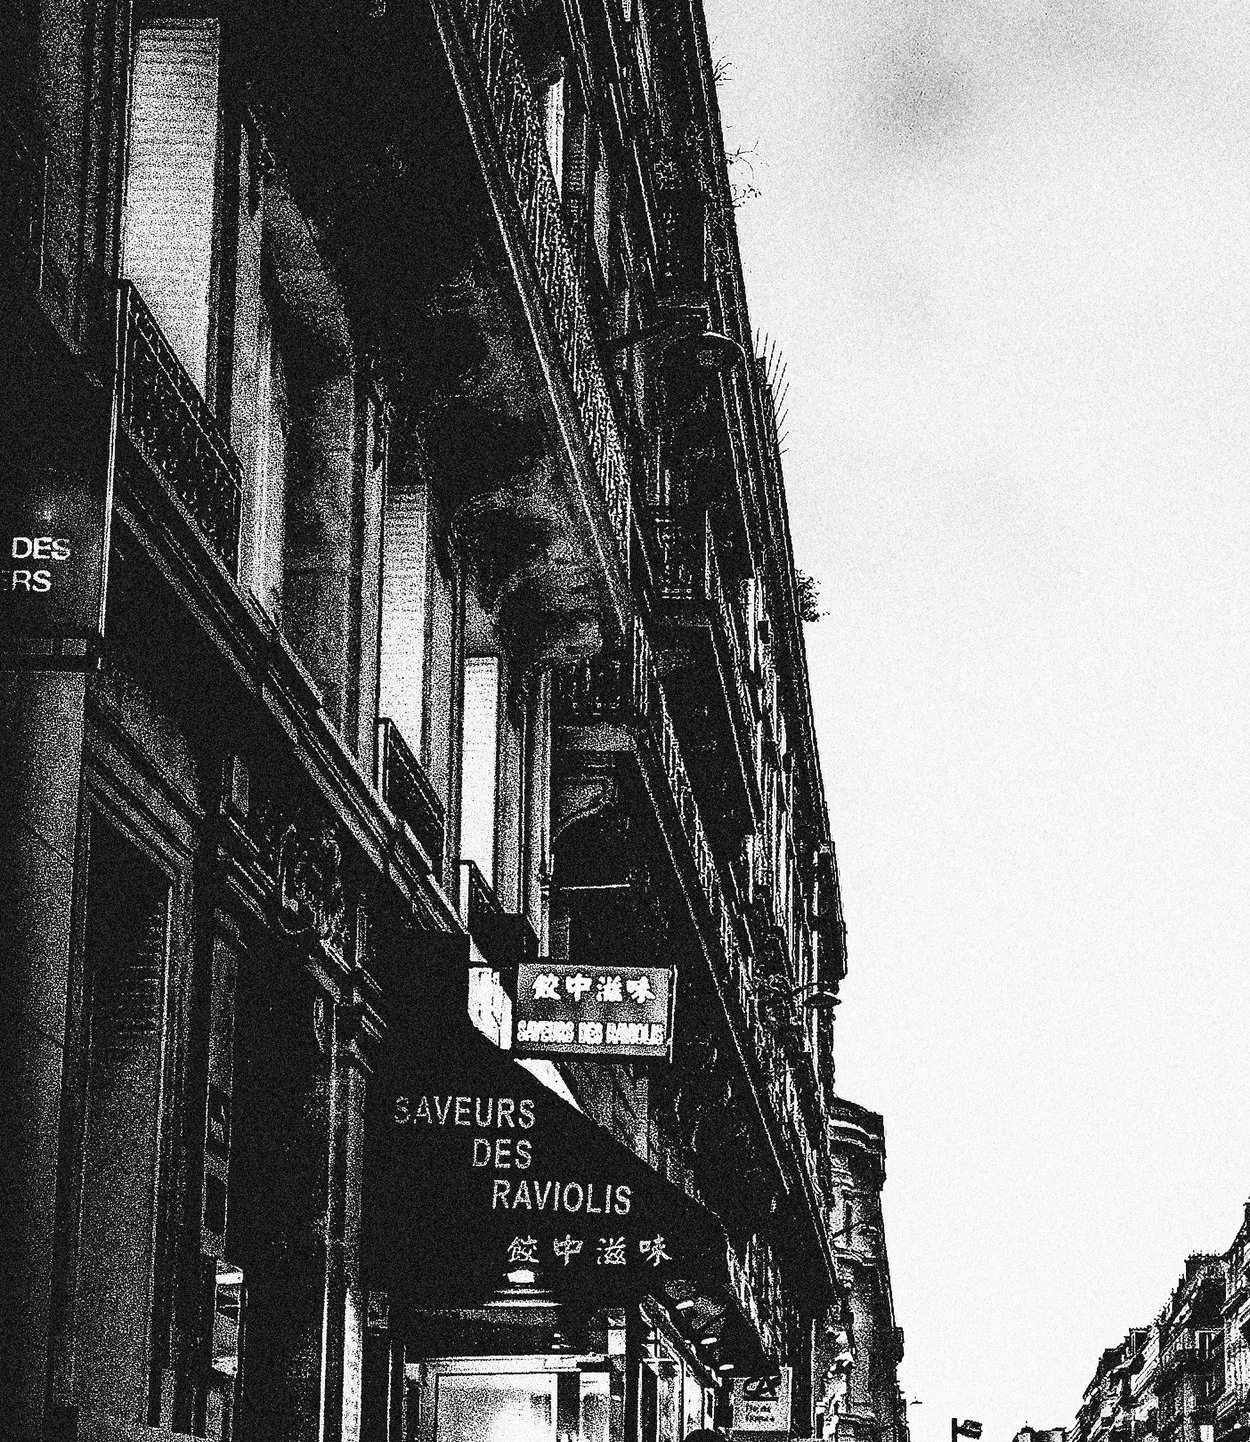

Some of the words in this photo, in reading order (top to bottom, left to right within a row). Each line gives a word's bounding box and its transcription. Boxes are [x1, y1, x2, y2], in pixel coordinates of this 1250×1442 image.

[12, 537, 71, 560] DES
[517, 1020, 574, 1043] SAVEURS
[578, 1021, 603, 1044] DES
[606, 1022, 665, 1045] RAVIOLIS
[394, 1095, 535, 1129] SAVEURS
[472, 1138, 532, 1169] DES
[492, 1179, 632, 1215] RAVIOLIS
